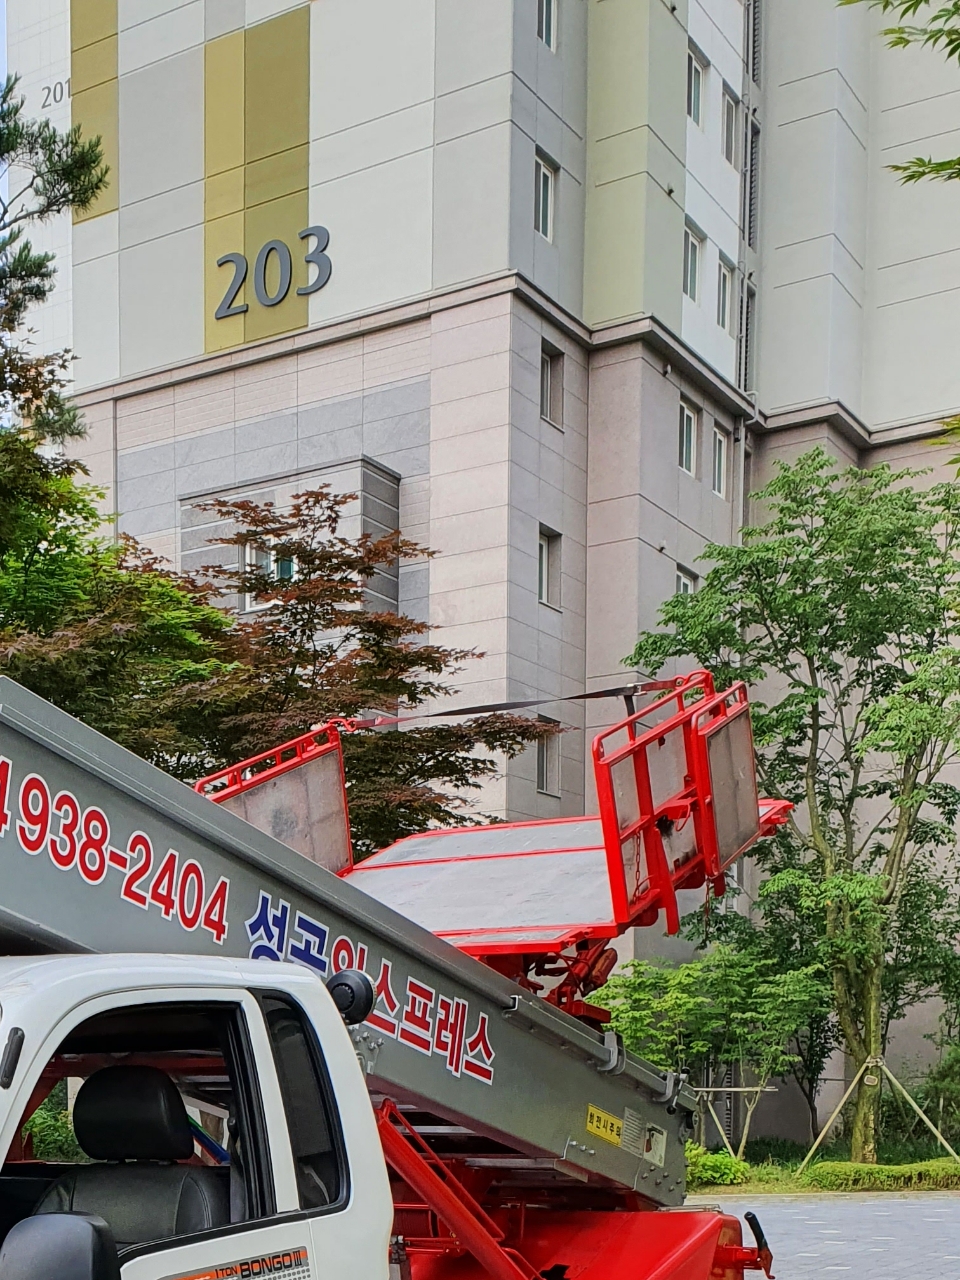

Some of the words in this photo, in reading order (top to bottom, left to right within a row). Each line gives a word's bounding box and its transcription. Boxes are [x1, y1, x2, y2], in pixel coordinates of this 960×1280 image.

[41, 77, 71, 109] 201
[215, 226, 332, 320] 203
[239, 1252, 293, 1279] BONGO
